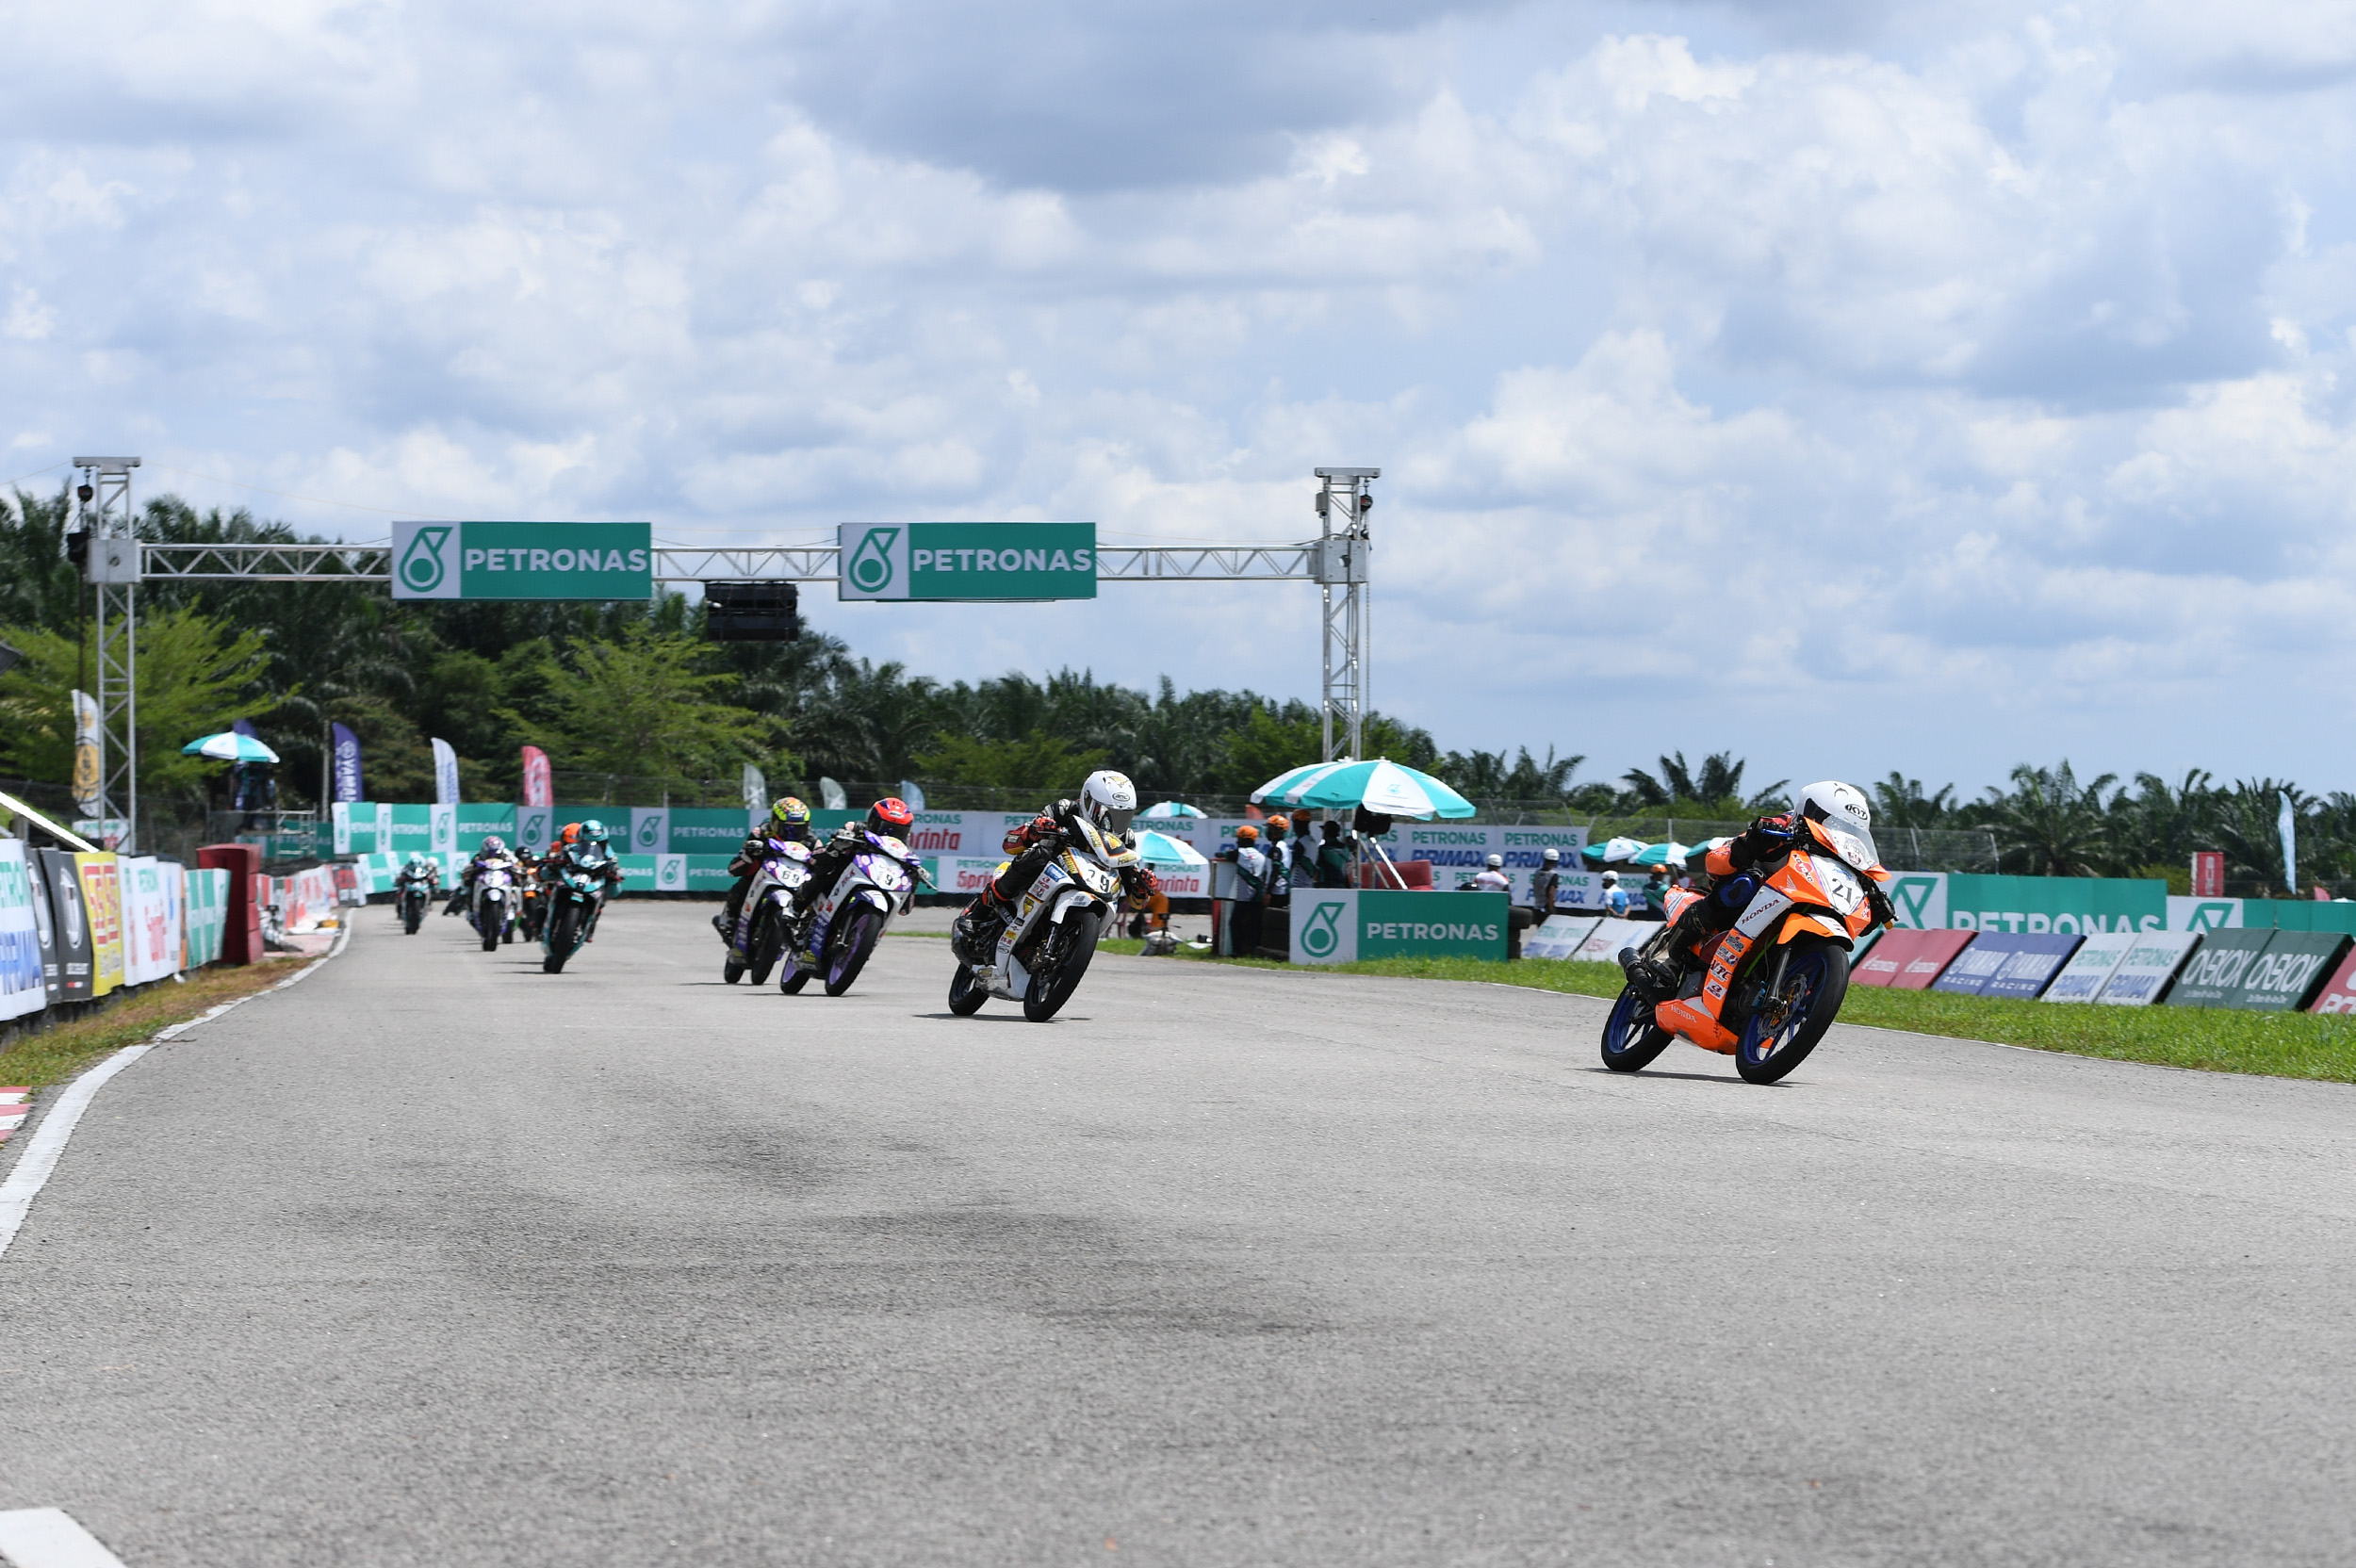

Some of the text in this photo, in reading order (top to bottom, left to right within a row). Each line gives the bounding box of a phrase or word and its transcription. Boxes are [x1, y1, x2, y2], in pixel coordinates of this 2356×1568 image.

[465, 548, 646, 572] PETRONAS
[912, 548, 1092, 572] PETRONAS
[912, 813, 962, 825] RONAS
[1131, 820, 1194, 831] ETRONAS
[458, 822, 514, 834] PETRONAS
[673, 826, 745, 838] PETRONAS
[908, 827, 962, 851] printa
[1412, 830, 1486, 845] PETRONAS
[1504, 832, 1578, 846] PETRONAS
[957, 859, 1000, 869] PETRON
[1411, 849, 1489, 868] PRIMAX
[1502, 851, 1578, 869] PRIAX
[689, 868, 728, 877] PETRON
[1154, 864, 1201, 873] TRONAS
[781, 870, 800, 884] 69
[1157, 875, 1200, 893] printa
[1832, 877, 1853, 905] 21
[1742, 899, 1780, 925] HONDA
[1953, 910, 2161, 936] PETRONAS
[1367, 922, 1499, 941] PETRONAS
[1942, 975, 1983, 987] RACING
[1990, 981, 2037, 991] RACING
[1671, 1004, 1697, 1023] HONDA
